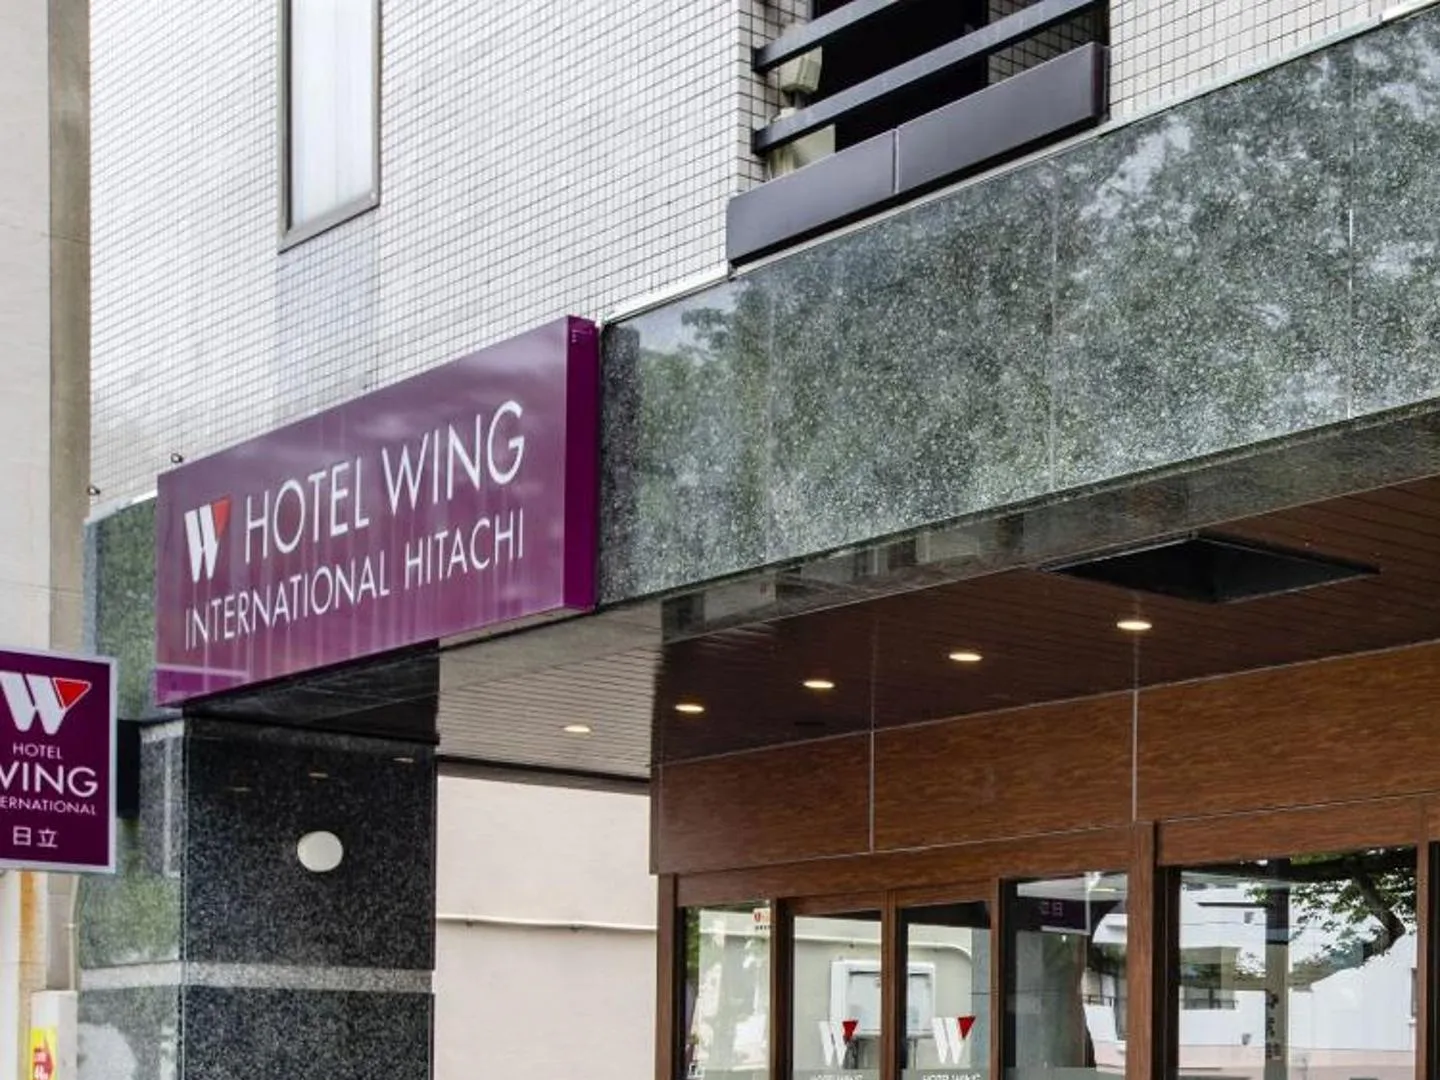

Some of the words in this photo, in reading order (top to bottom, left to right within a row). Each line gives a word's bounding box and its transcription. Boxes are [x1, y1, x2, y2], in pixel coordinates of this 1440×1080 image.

[243, 458, 369, 564] HOTEL
[382, 400, 525, 515] WING
[185, 557, 390, 650] INTERNATIONAL
[404, 508, 524, 591] HITACHI
[13, 743, 62, 760] HOTEL
[13, 826, 58, 848] 日立
